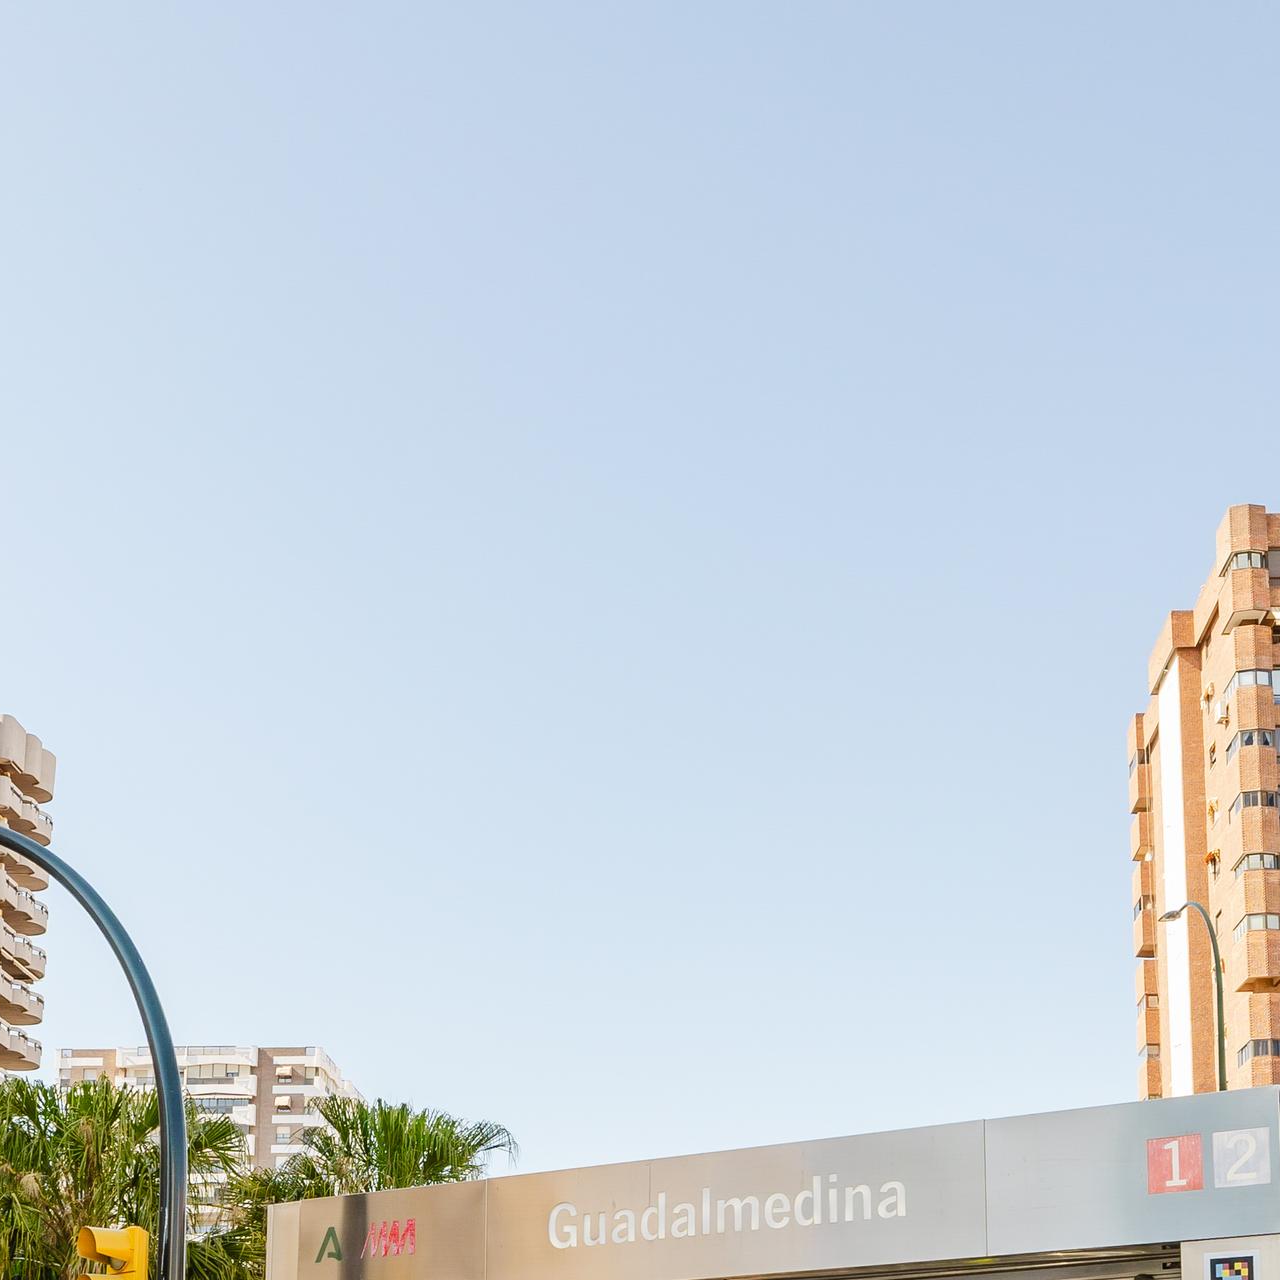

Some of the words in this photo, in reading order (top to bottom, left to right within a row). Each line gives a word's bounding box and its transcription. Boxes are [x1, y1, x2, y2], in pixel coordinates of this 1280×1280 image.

[1164, 1140, 1188, 1187] 1
[1226, 1133, 1258, 1181] 2
[548, 1174, 907, 1249] Guadalmedina
